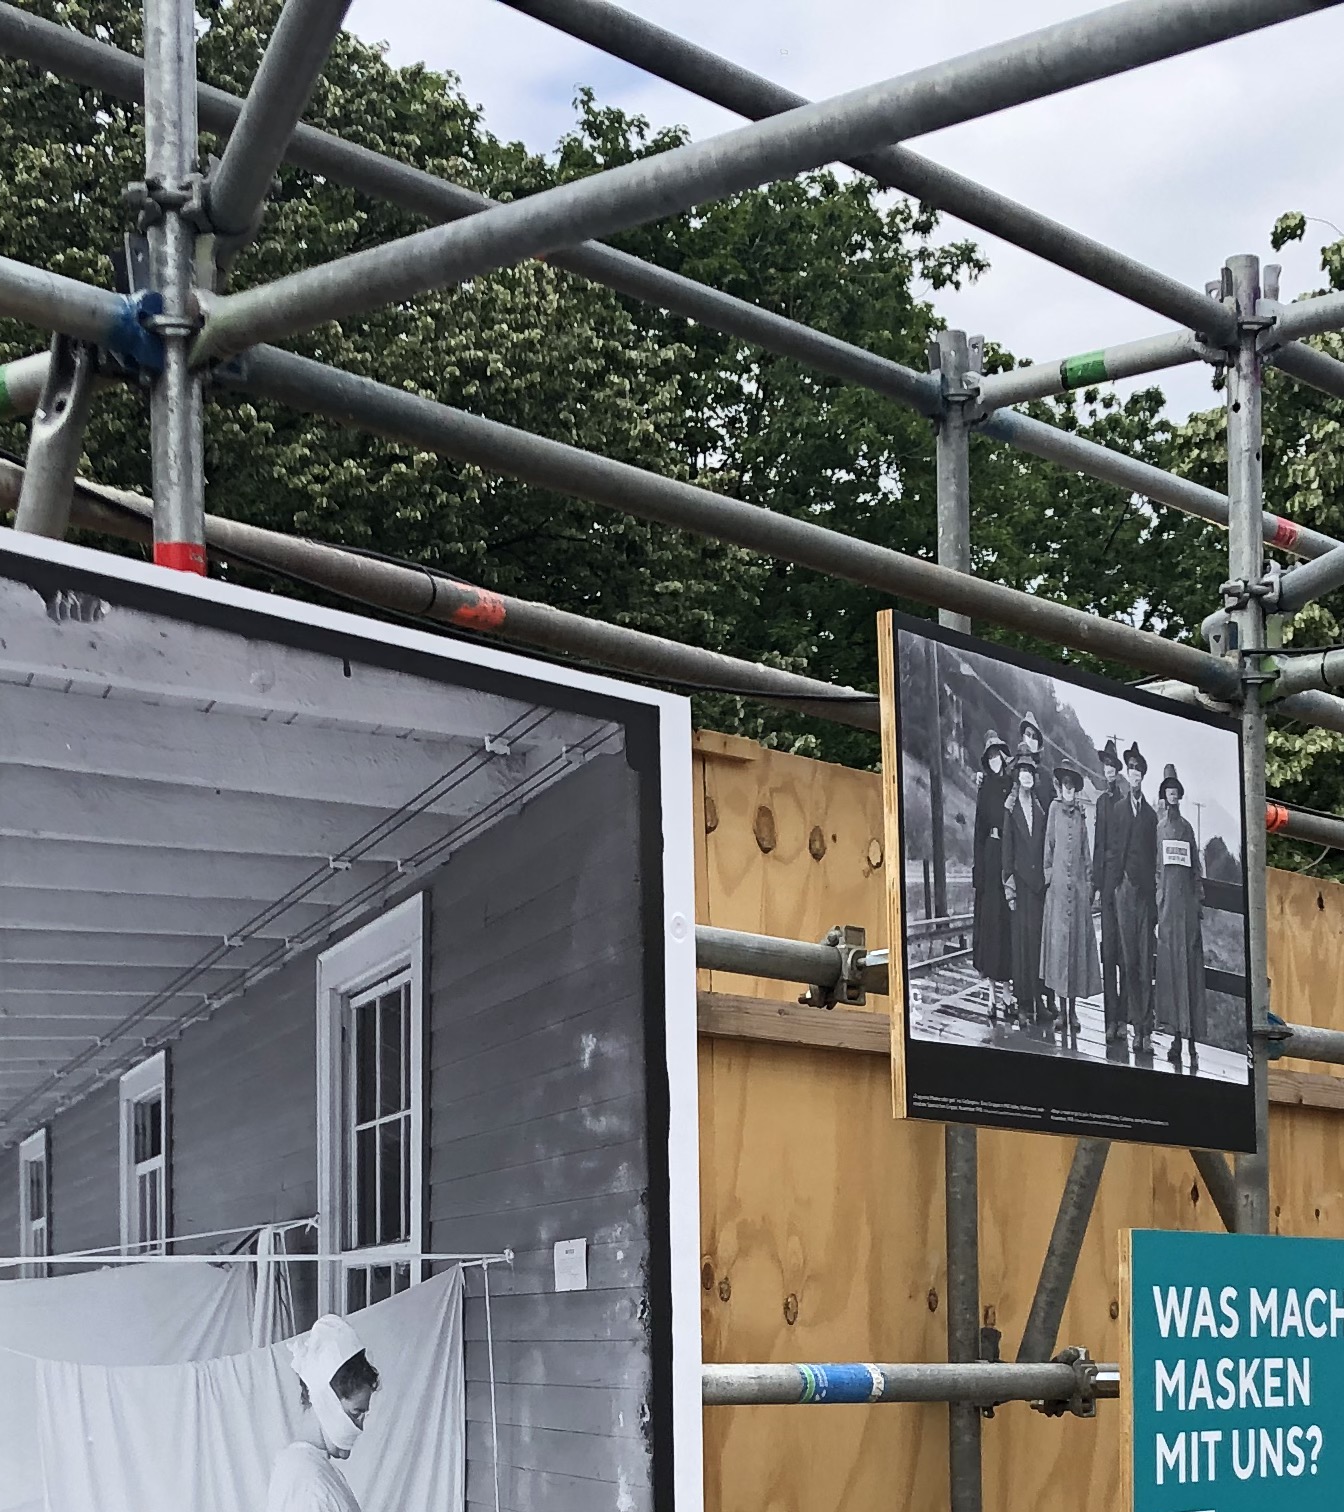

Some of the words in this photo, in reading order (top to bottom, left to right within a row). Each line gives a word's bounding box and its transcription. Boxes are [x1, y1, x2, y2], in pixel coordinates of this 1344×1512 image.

[1152, 1286, 1240, 1339] WAS
[1154, 1357, 1311, 1411] MASKEN
[1156, 1430, 1222, 1485] MIT
[1232, 1425, 1324, 1481] UNS?
